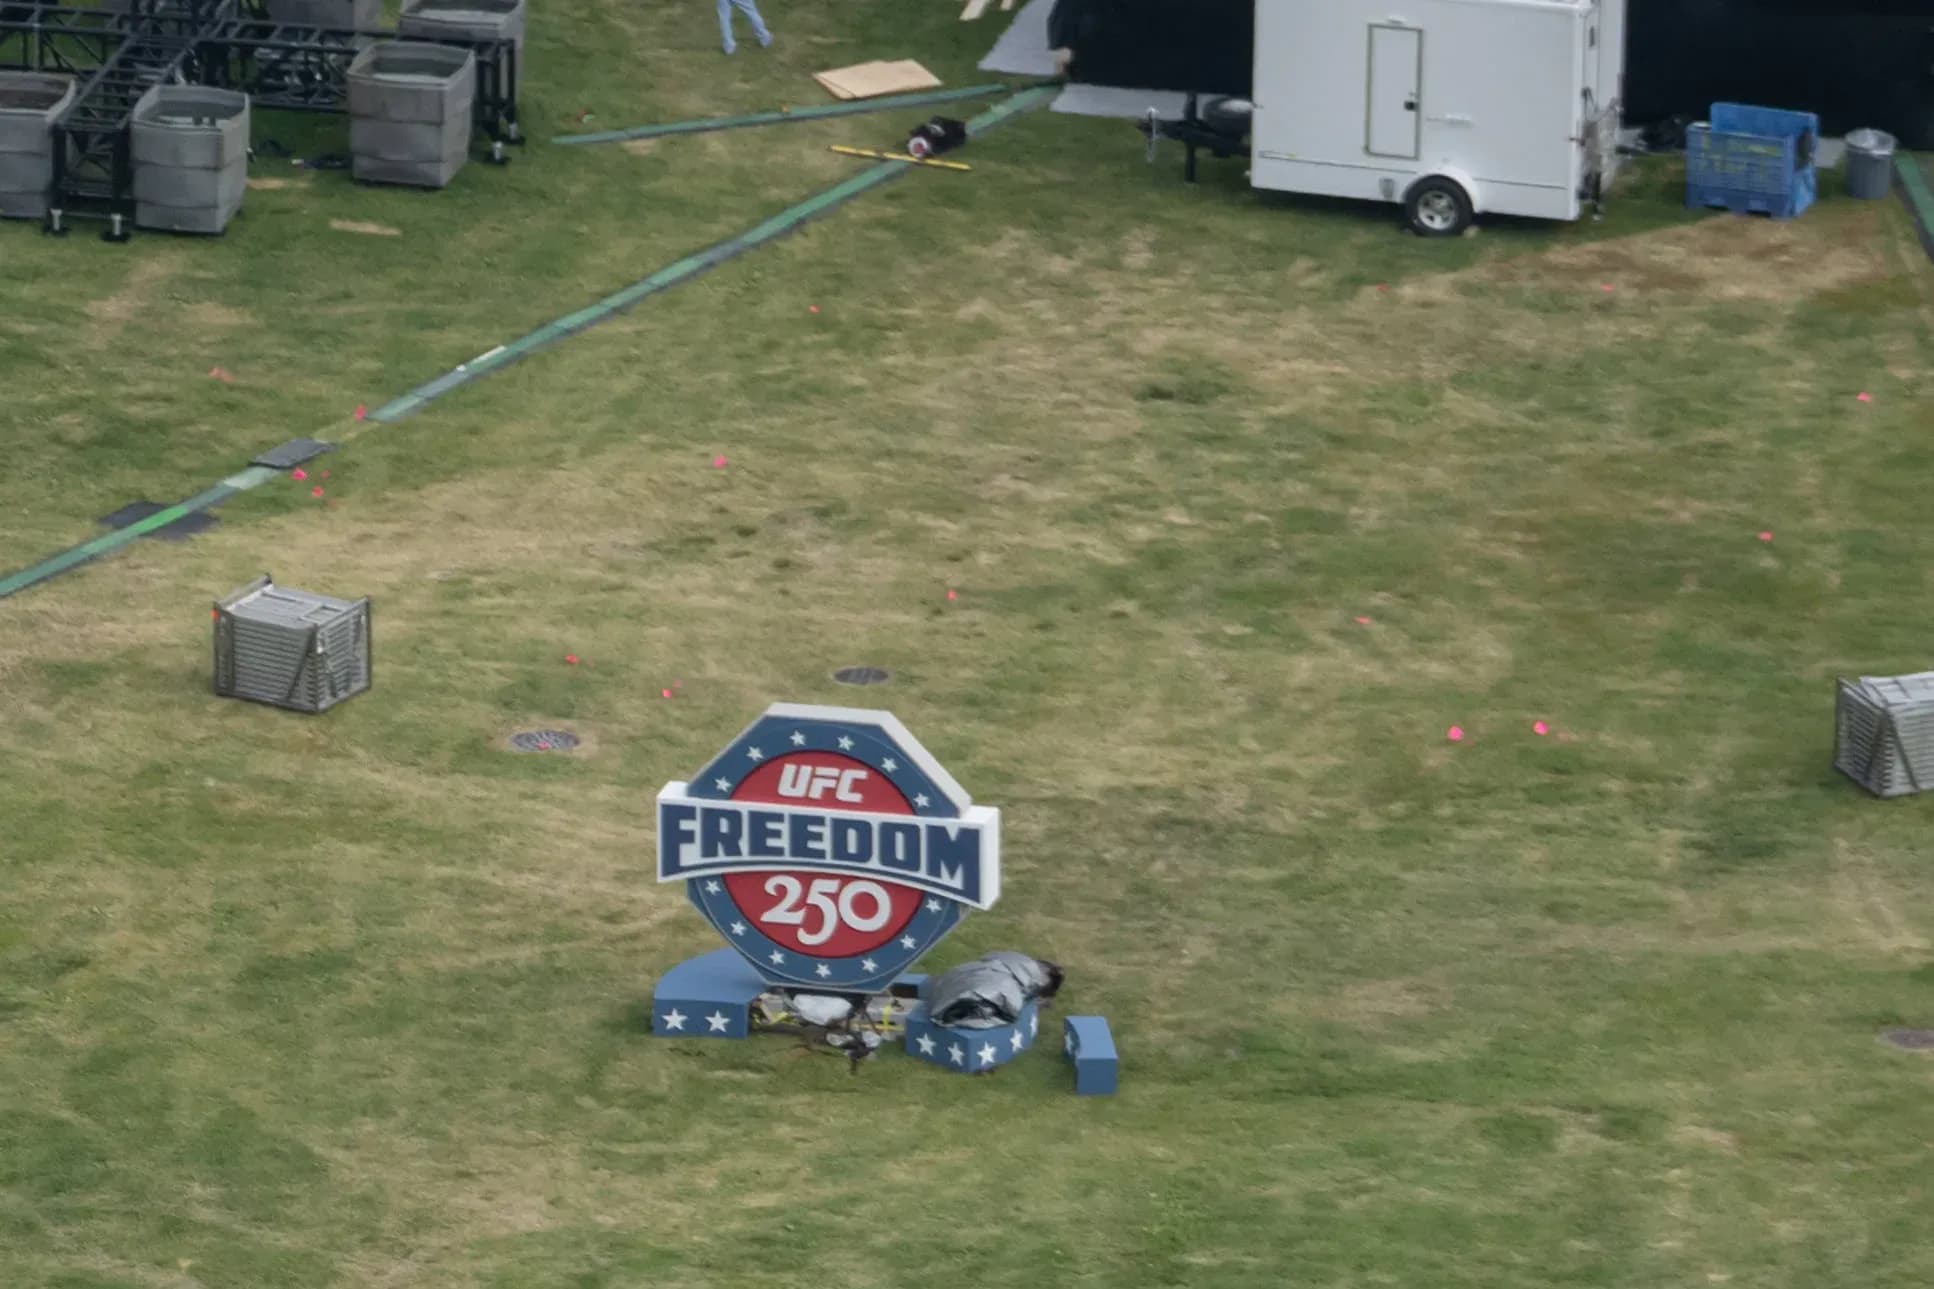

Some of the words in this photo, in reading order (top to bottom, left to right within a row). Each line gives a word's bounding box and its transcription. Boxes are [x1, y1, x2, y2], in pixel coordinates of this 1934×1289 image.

[777, 763, 868, 802] UFC
[661, 803, 981, 903] FREEDOM
[760, 875, 891, 945] 250
